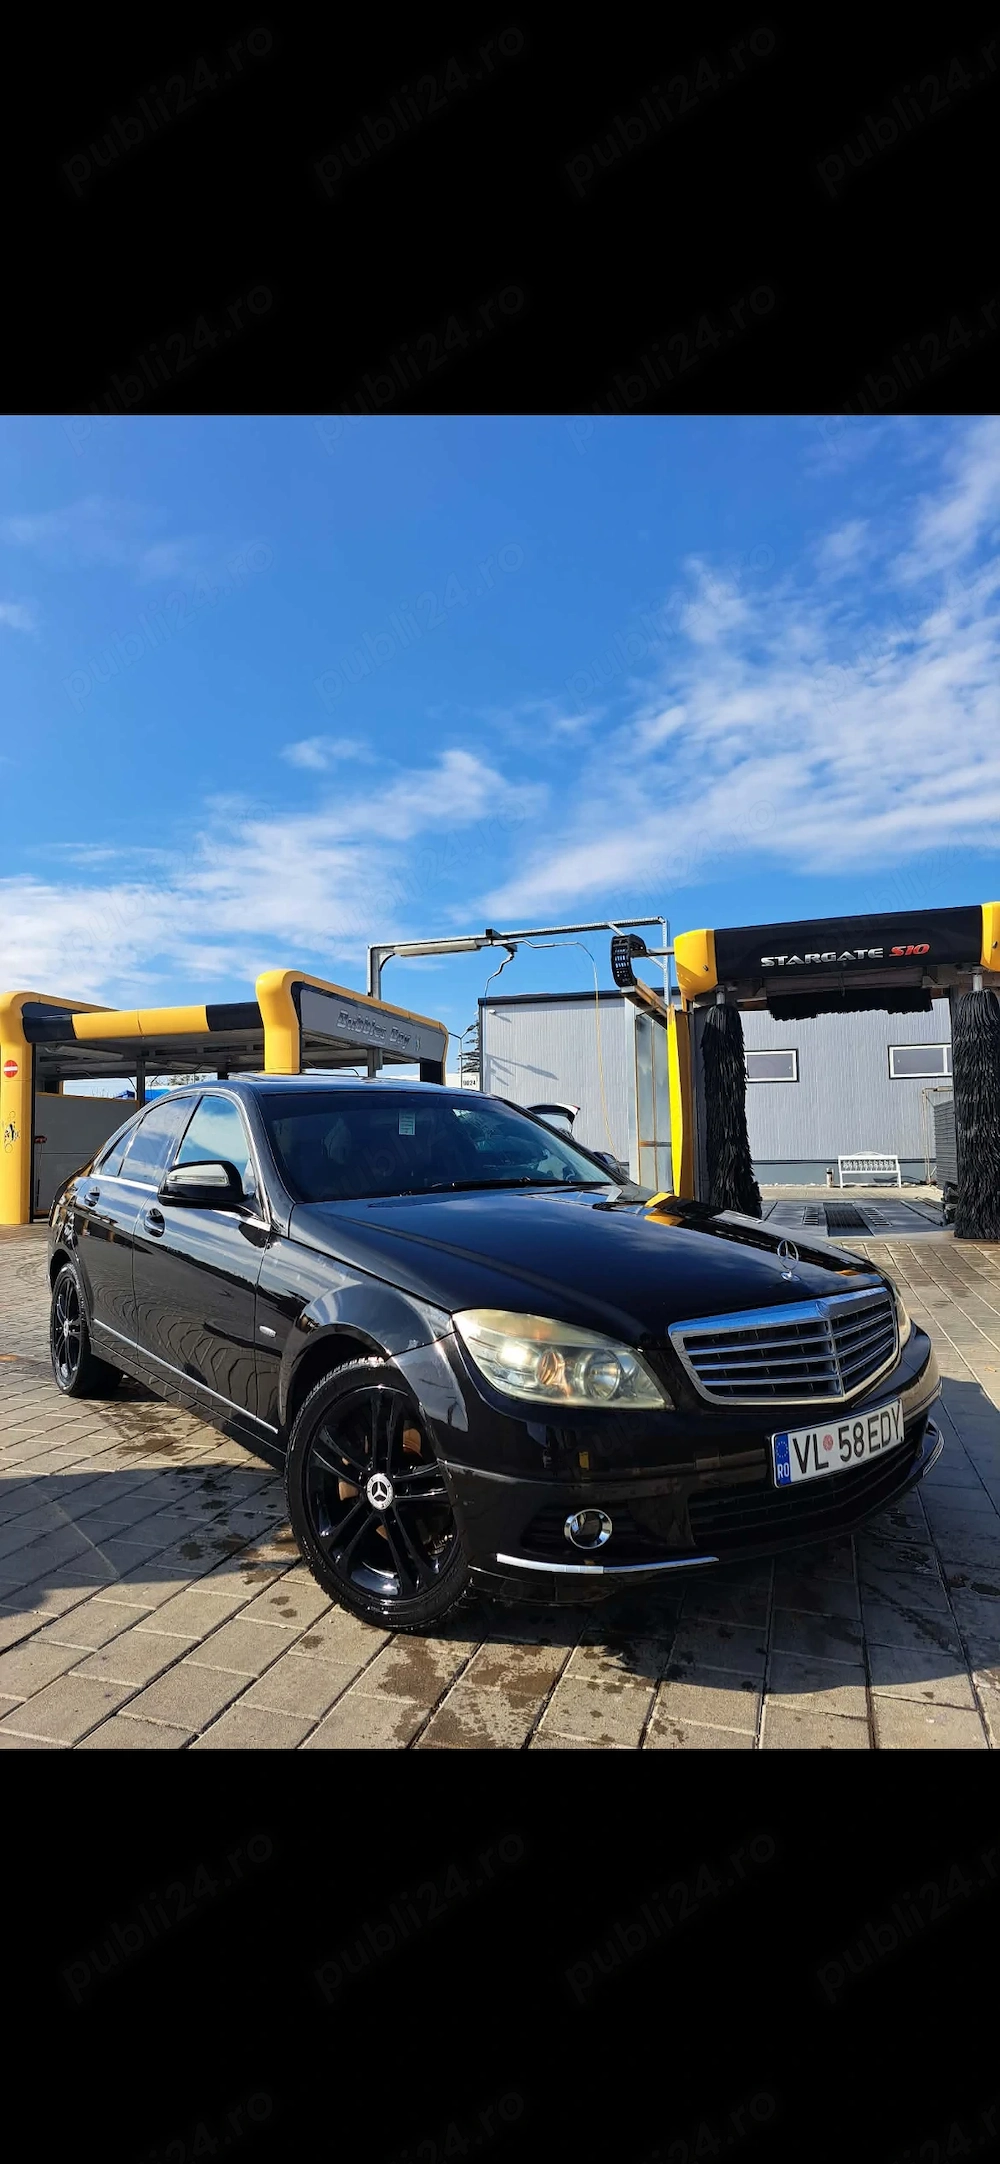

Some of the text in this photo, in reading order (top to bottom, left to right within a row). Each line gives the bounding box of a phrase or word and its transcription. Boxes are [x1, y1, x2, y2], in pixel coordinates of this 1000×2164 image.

[761, 947, 884, 967] STARGATE
[792, 1433, 829, 1475] VL
[777, 1463, 790, 1480] RO
